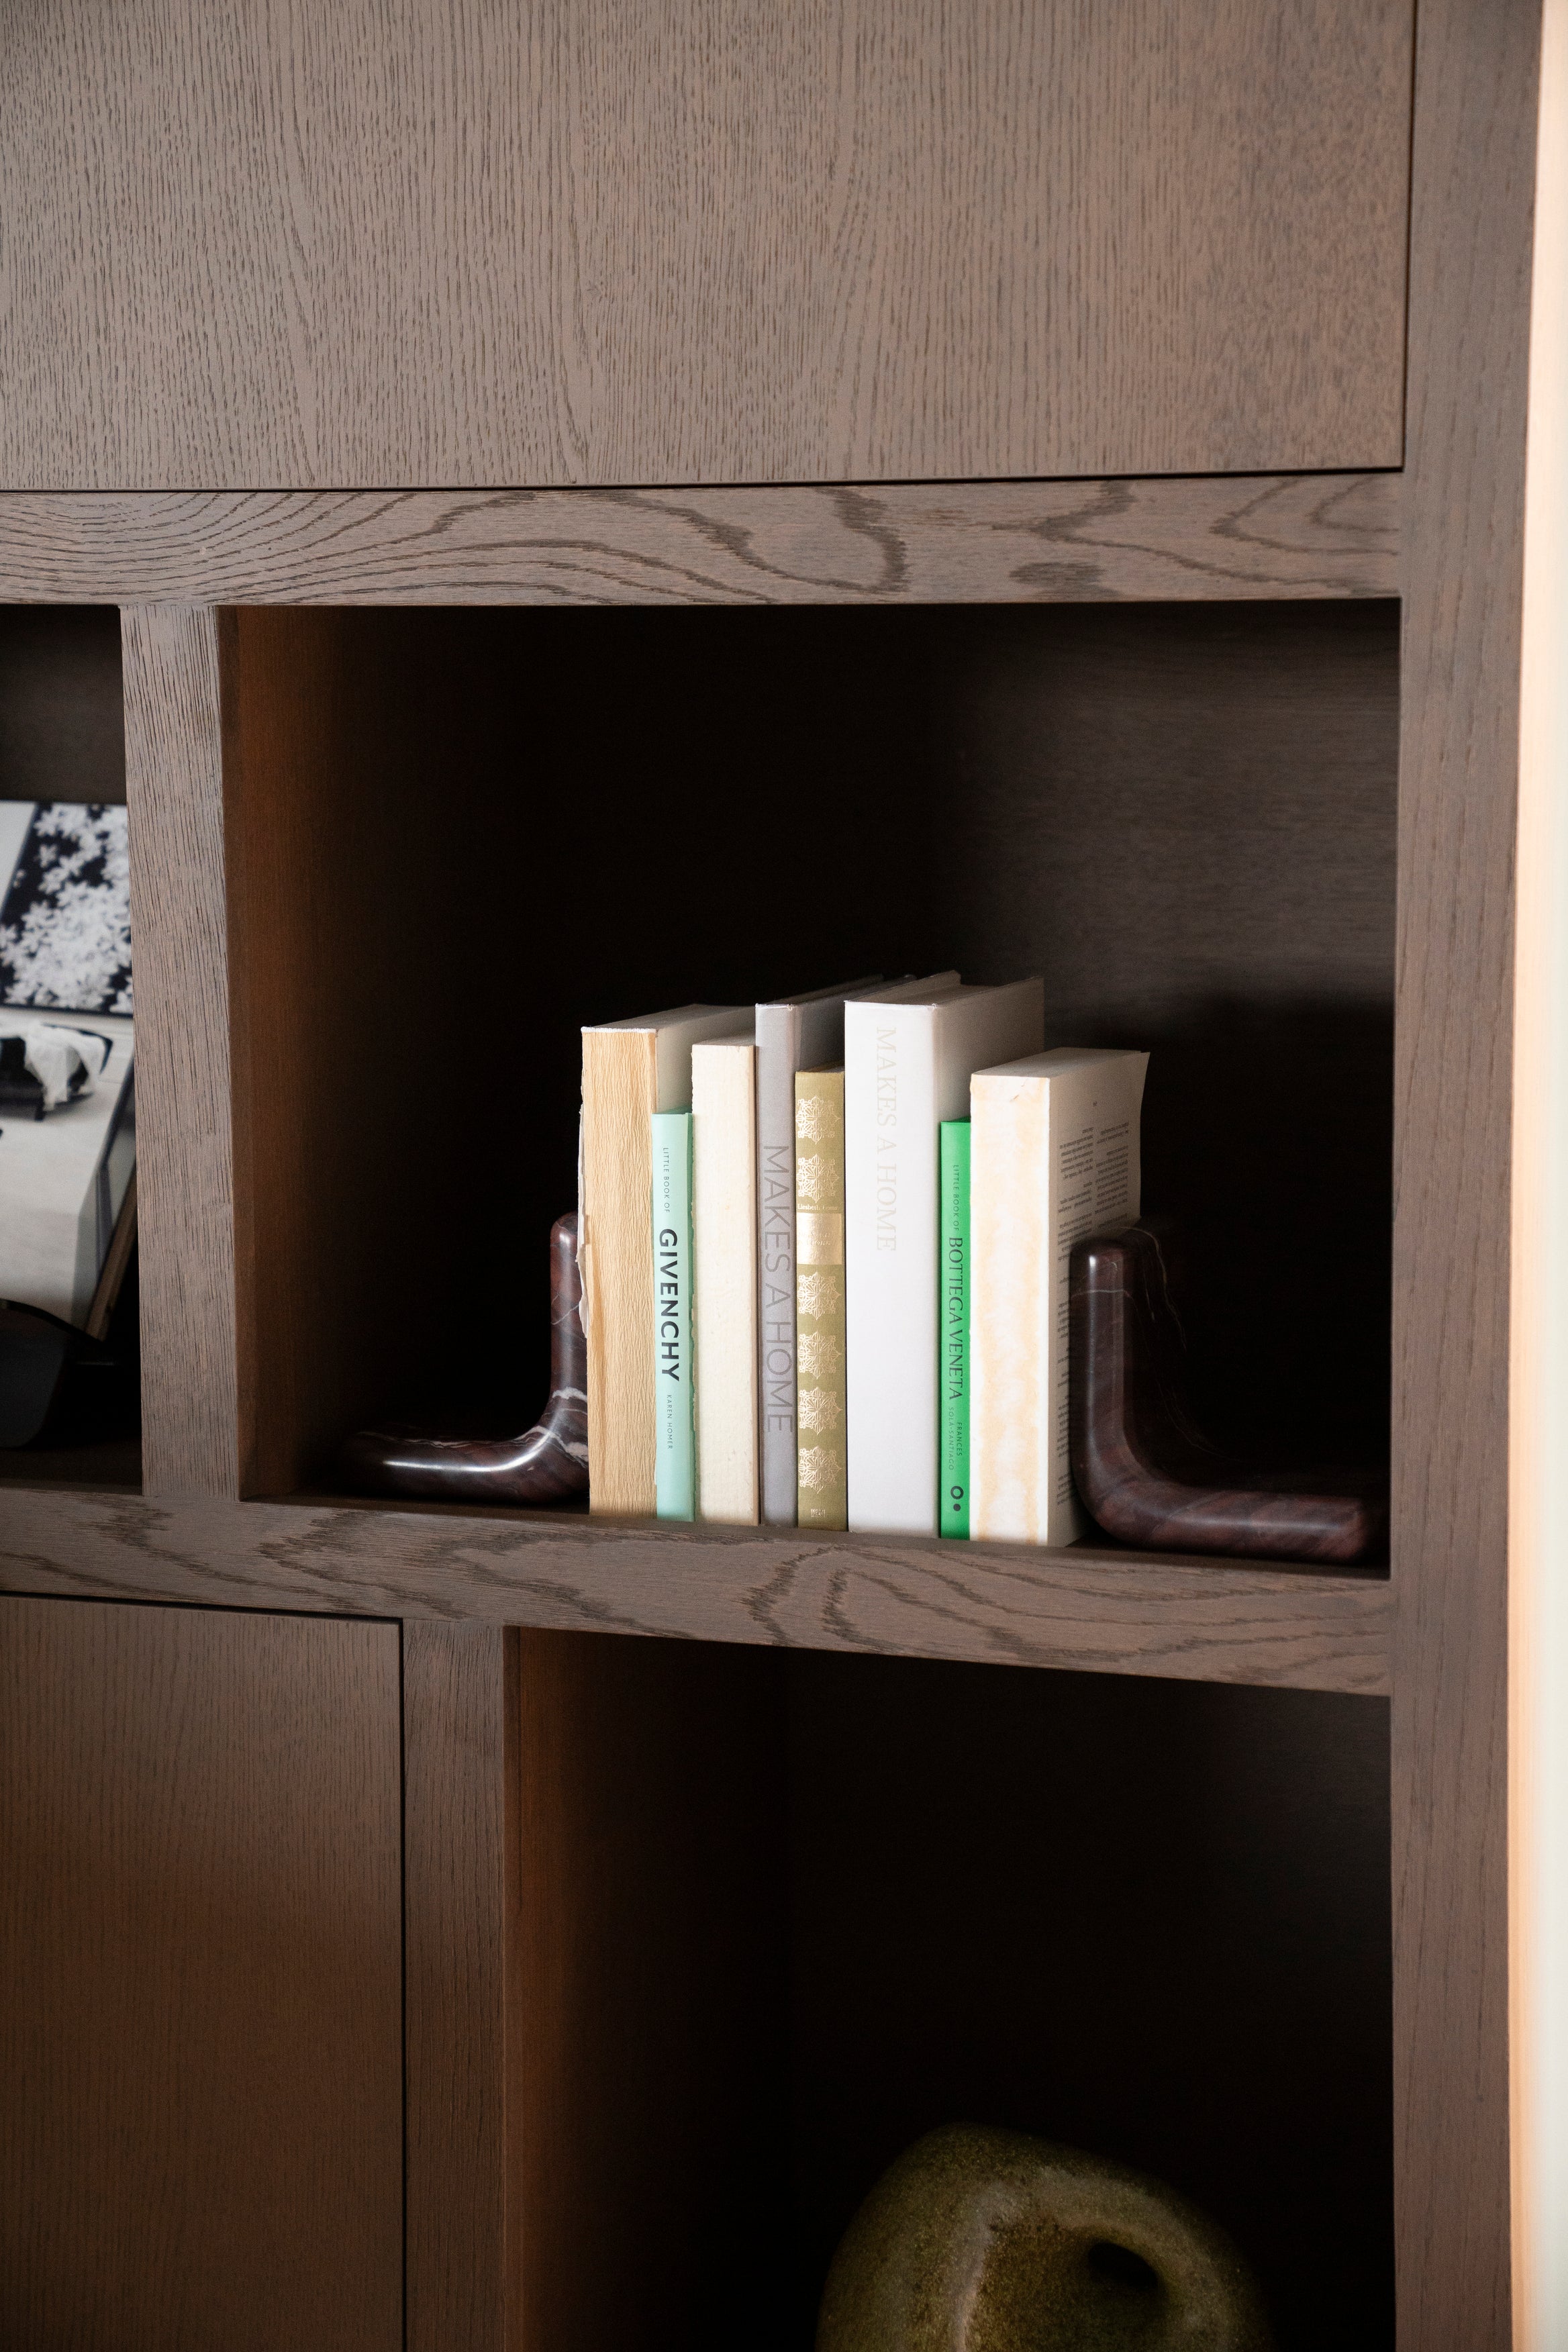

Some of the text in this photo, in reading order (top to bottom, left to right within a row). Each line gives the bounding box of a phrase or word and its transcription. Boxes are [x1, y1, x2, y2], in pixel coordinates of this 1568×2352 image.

[665, 1202, 670, 1212] OF
[877, 1027, 897, 1251] MAKES A HOME
[659, 1228, 680, 1381] GIVENCHY
[763, 1146, 793, 1432] MAKES A HOME
[953, 1221, 959, 1231] OF
[948, 1237, 963, 1400] BOTTEGA VENETA
